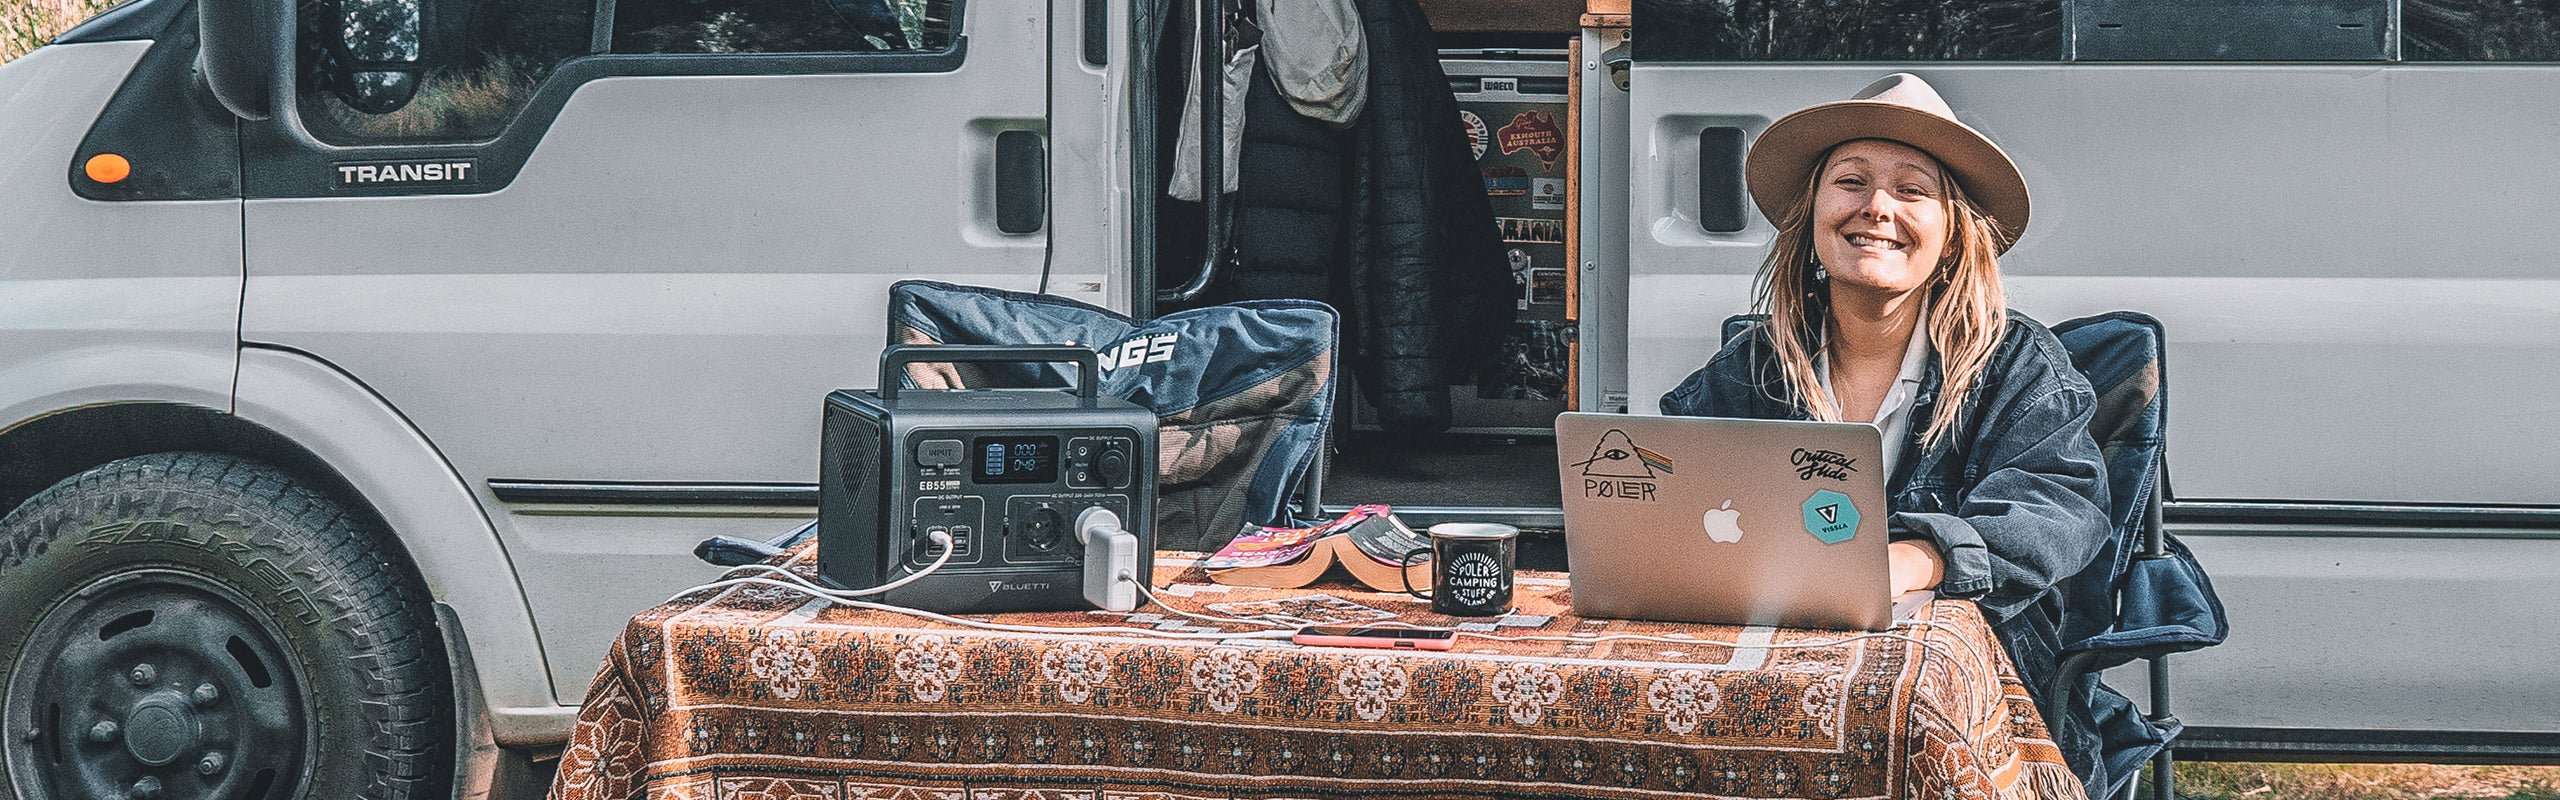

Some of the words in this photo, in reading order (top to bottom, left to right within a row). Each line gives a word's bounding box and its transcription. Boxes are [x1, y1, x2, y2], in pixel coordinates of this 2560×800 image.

[1484, 81, 1514, 91] WAECO
[1510, 130, 1552, 139] EXMOUTH
[1506, 137, 1557, 147] AUSTRALIA
[338, 163, 471, 183] TRANSIT
[1097, 332, 1178, 372] NGS
[928, 449, 952, 457] INPUT
[1014, 444, 1036, 456] 000
[1790, 447, 1858, 472] Critical
[1796, 462, 1848, 480] Slide
[920, 481, 946, 490] EB55
[1822, 523, 1848, 533] VISSLA
[1459, 563, 1489, 577] POLER
[1002, 583, 1050, 591] BLUETTI
[1449, 577, 1497, 588] CAMPING
[1452, 589, 1486, 606] PORTLAND
[1462, 588, 1486, 598] STUFF
